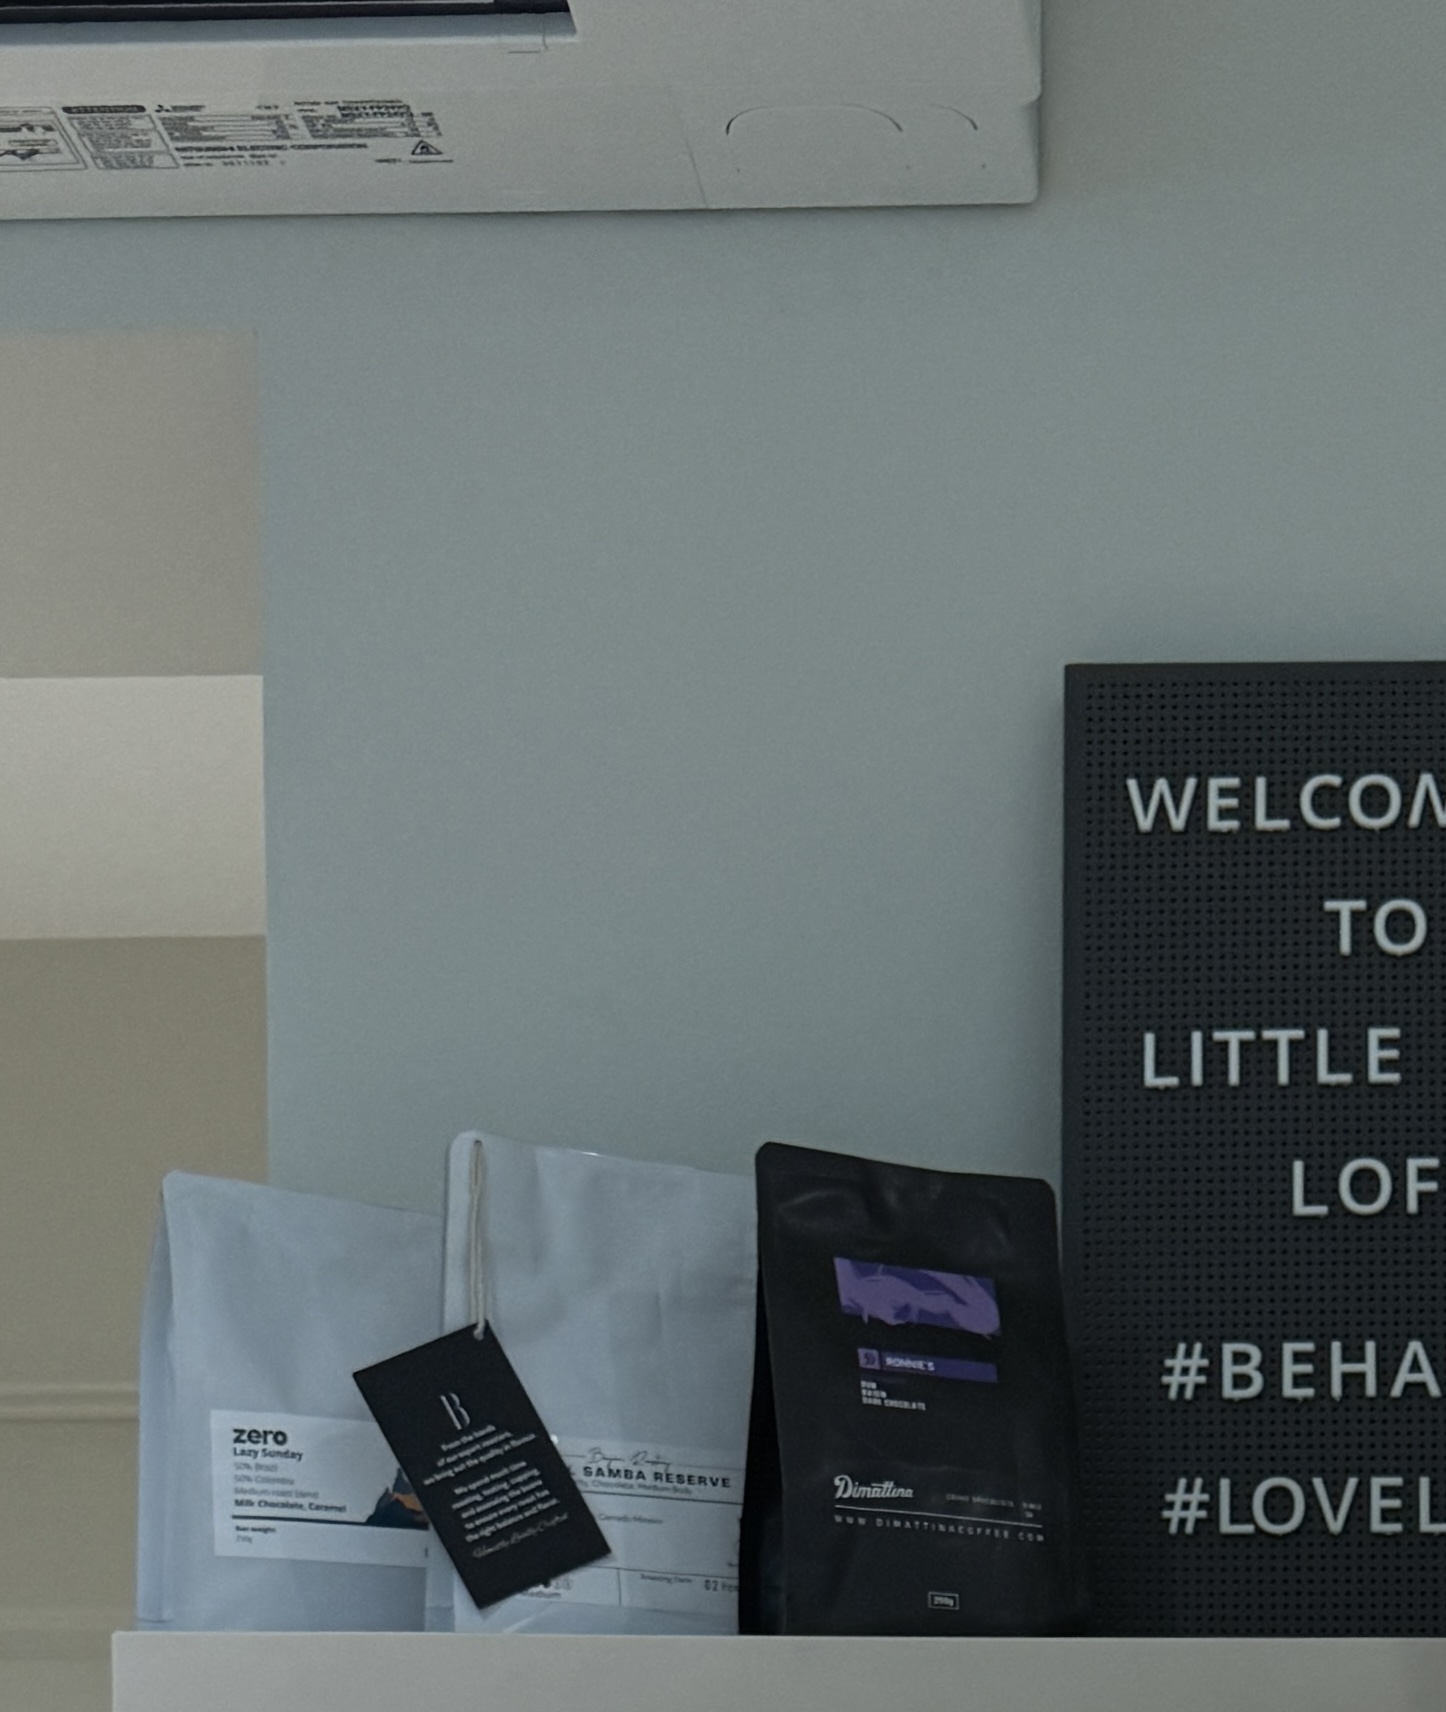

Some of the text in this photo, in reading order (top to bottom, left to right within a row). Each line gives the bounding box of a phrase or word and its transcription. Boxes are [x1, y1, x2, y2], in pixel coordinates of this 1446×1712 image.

[1324, 900, 1428, 956] TO
[1143, 1028, 1401, 1089] LITTLE
[232, 1428, 288, 1445] zero
[233, 1447, 303, 1462] Lazy Sunday
[583, 1466, 647, 1481] SAMBA
[653, 1472, 731, 1488] RESERVE
[834, 1474, 914, 1499] Dimattina
[234, 1499, 254, 1507] Milk
[308, 1502, 347, 1513] Caramel
